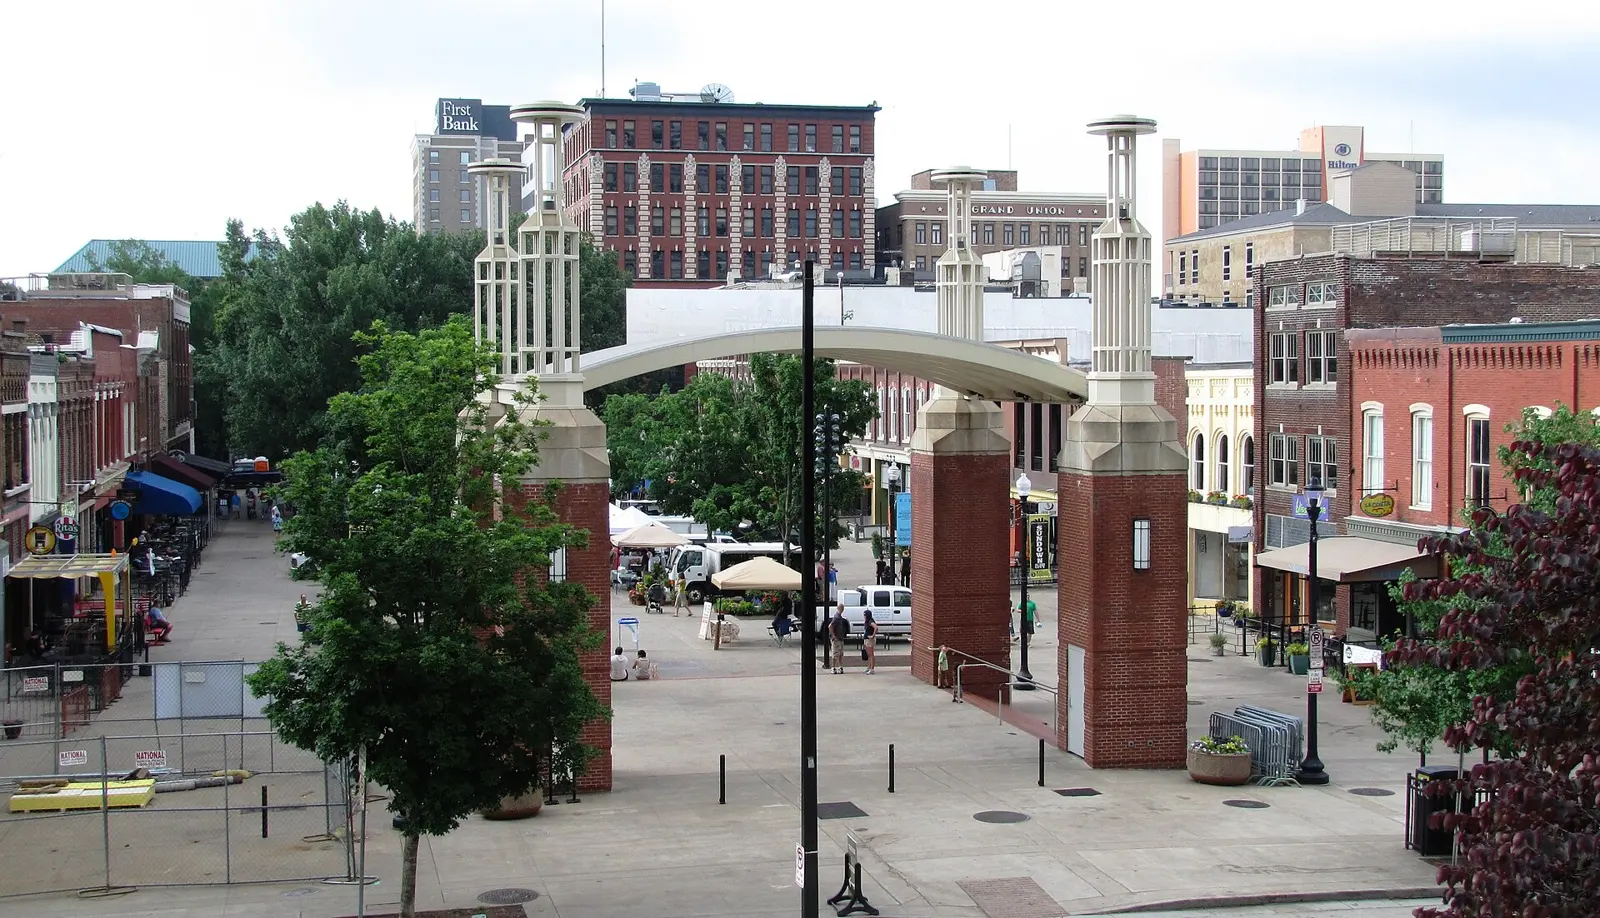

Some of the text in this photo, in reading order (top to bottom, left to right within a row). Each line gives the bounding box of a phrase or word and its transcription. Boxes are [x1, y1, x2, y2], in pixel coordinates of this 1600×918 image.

[442, 101, 471, 116] First
[442, 115, 479, 131] Bank
[1328, 160, 1358, 169] Hilton
[971, 205, 1065, 215] GRAND UNION
[55, 523, 79, 533] Rita's
[1036, 525, 1044, 564] SUNDOWN
[60, 751, 86, 760] NATIONAL
[136, 751, 165, 760] NATIONAL
